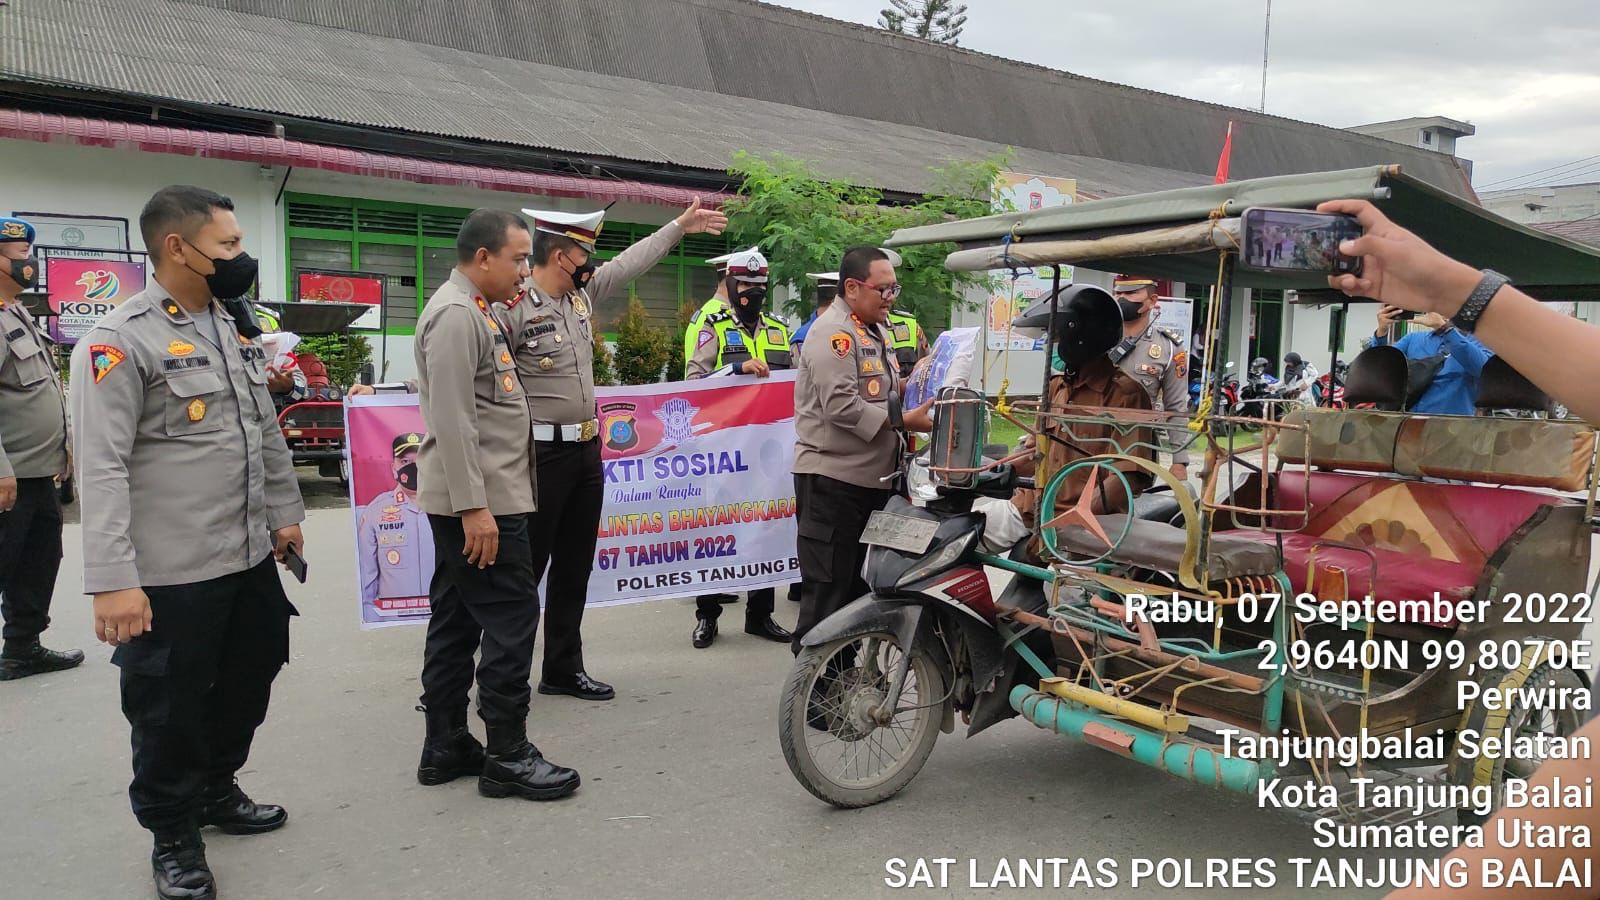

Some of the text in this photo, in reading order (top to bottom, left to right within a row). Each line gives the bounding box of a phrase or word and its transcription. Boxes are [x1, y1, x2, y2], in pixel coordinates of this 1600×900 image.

[653, 450, 749, 481] SOSIAL
[611, 488, 652, 504] Dalam
[379, 522, 405, 531] YUSUF
[598, 497, 797, 538] LINTAS BHAYANGKARA
[598, 534, 737, 571] 67 TAHUN 2022
[616, 571, 693, 592] POLRES
[697, 559, 785, 583] TANJUNG
[957, 577, 985, 593] HONDA
